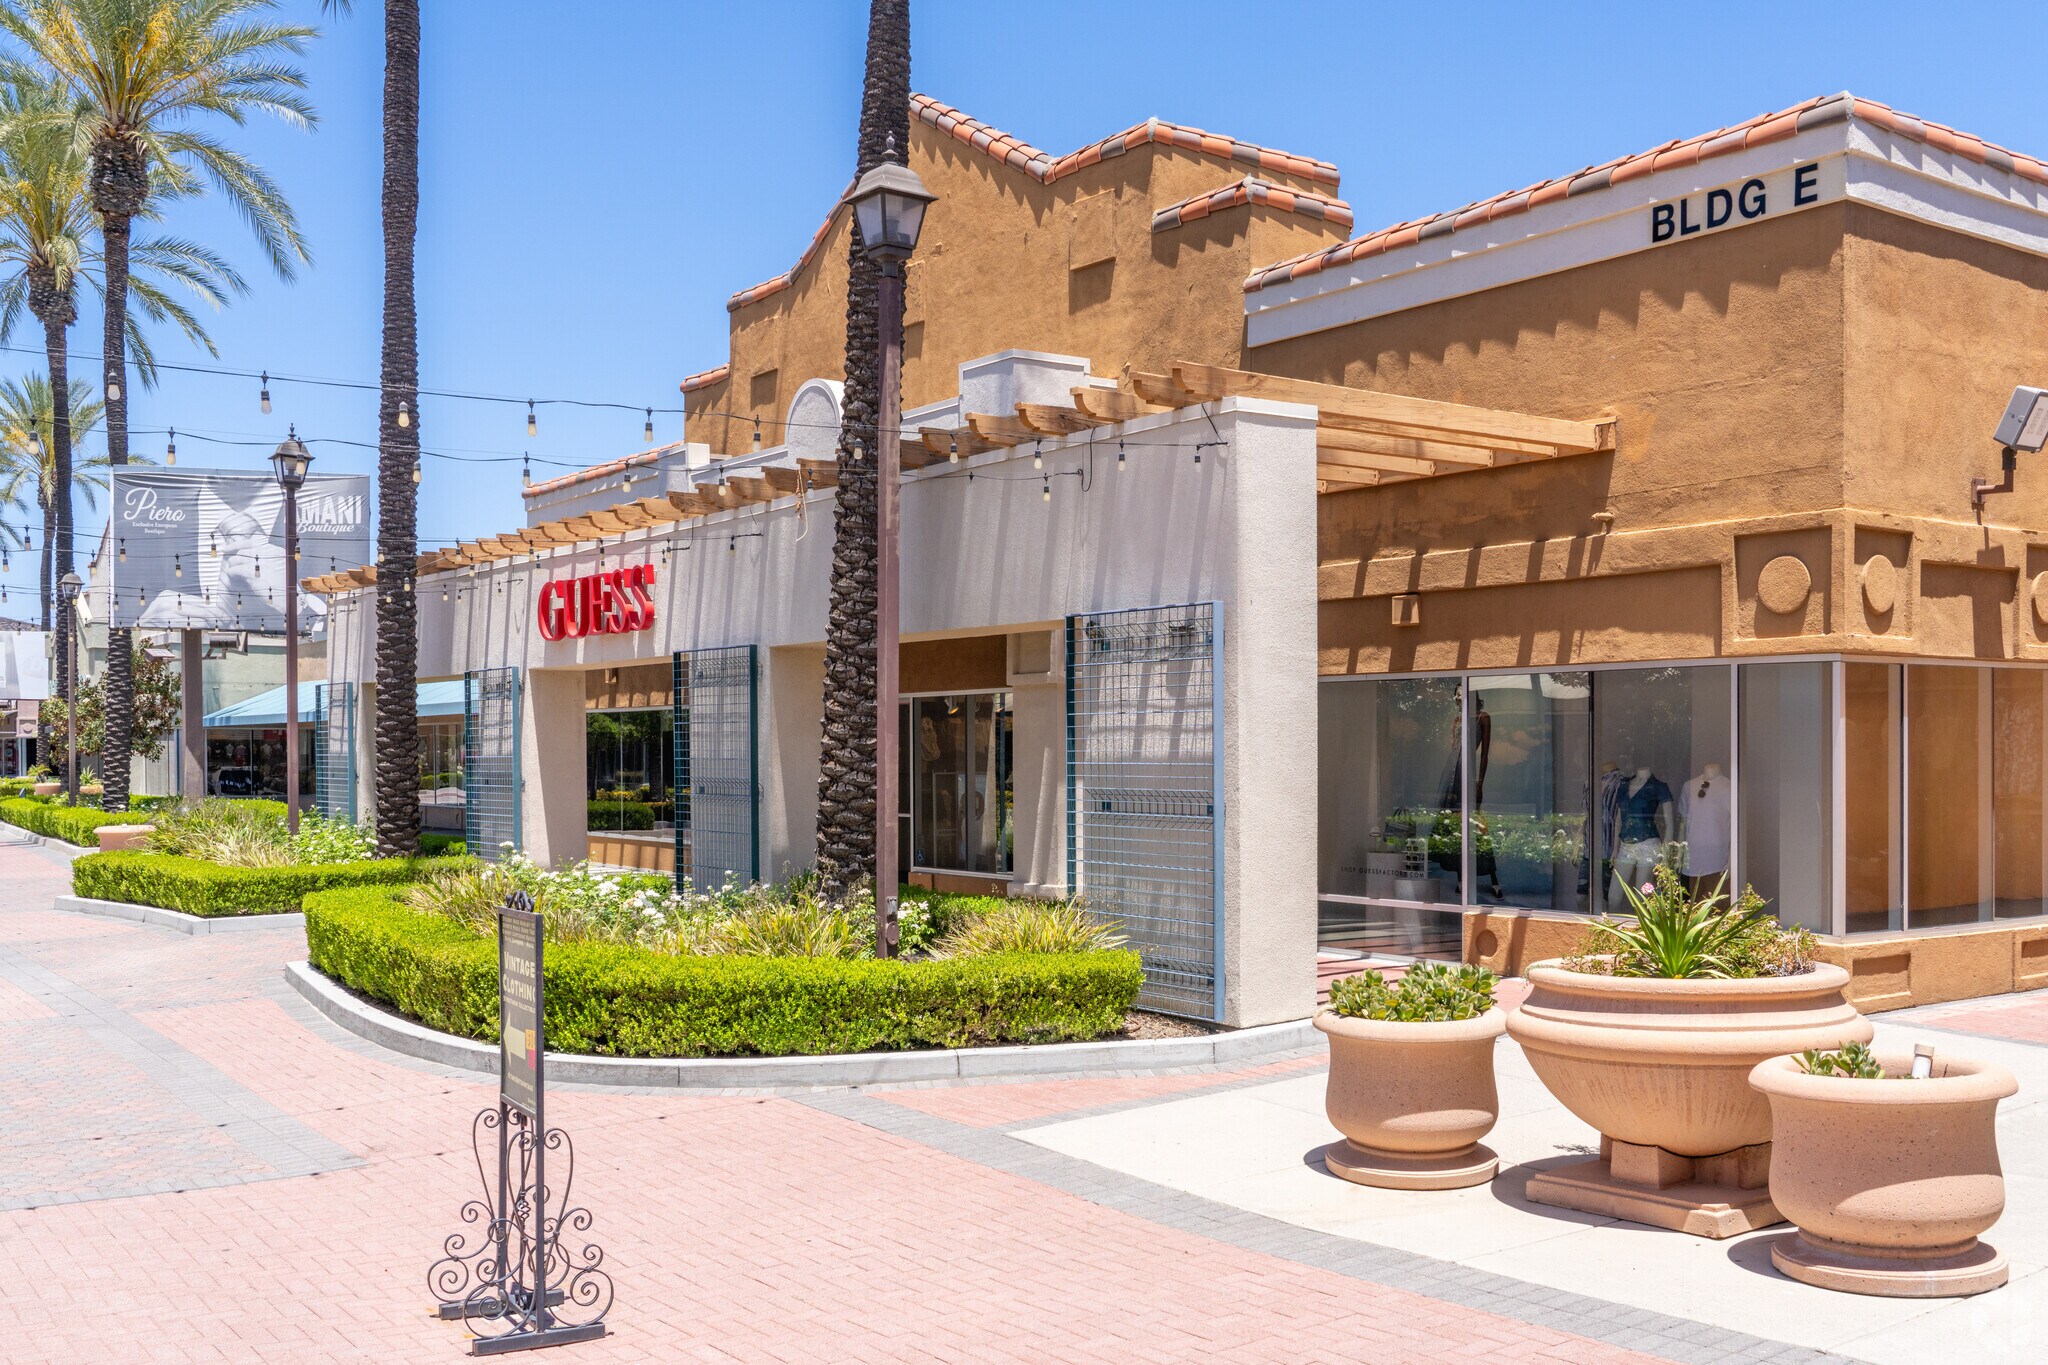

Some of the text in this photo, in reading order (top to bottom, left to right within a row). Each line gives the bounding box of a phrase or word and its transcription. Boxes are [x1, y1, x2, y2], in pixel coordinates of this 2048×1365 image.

[1652, 162, 1819, 243] BLDG E
[123, 487, 186, 521] Piero
[296, 522, 356, 536] Boutique
[538, 564, 655, 642] GUESS
[503, 950, 536, 979] VINTAGE
